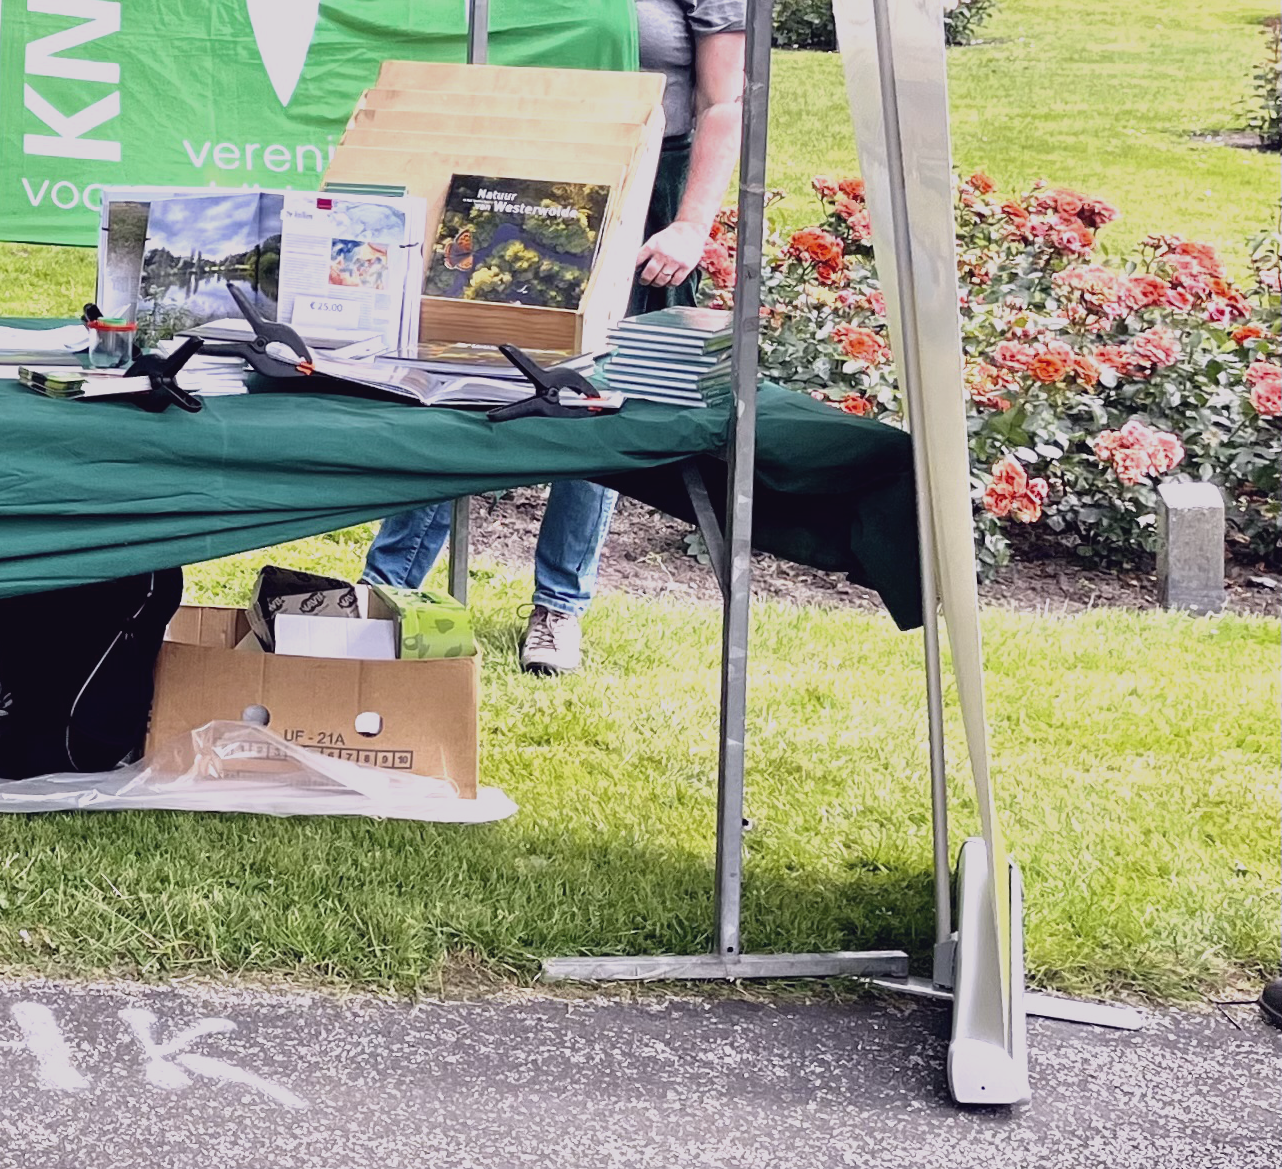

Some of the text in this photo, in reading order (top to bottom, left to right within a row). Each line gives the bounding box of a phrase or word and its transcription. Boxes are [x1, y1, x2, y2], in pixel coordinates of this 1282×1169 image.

[477, 188, 517, 201] Natuur
[475, 203, 491, 211] van
[493, 201, 579, 218] Westerwolde
[284, 729, 304, 742] UF
[317, 731, 346, 745] 21A
[364, 755, 370, 763] 8
[397, 756, 409, 764] 10
